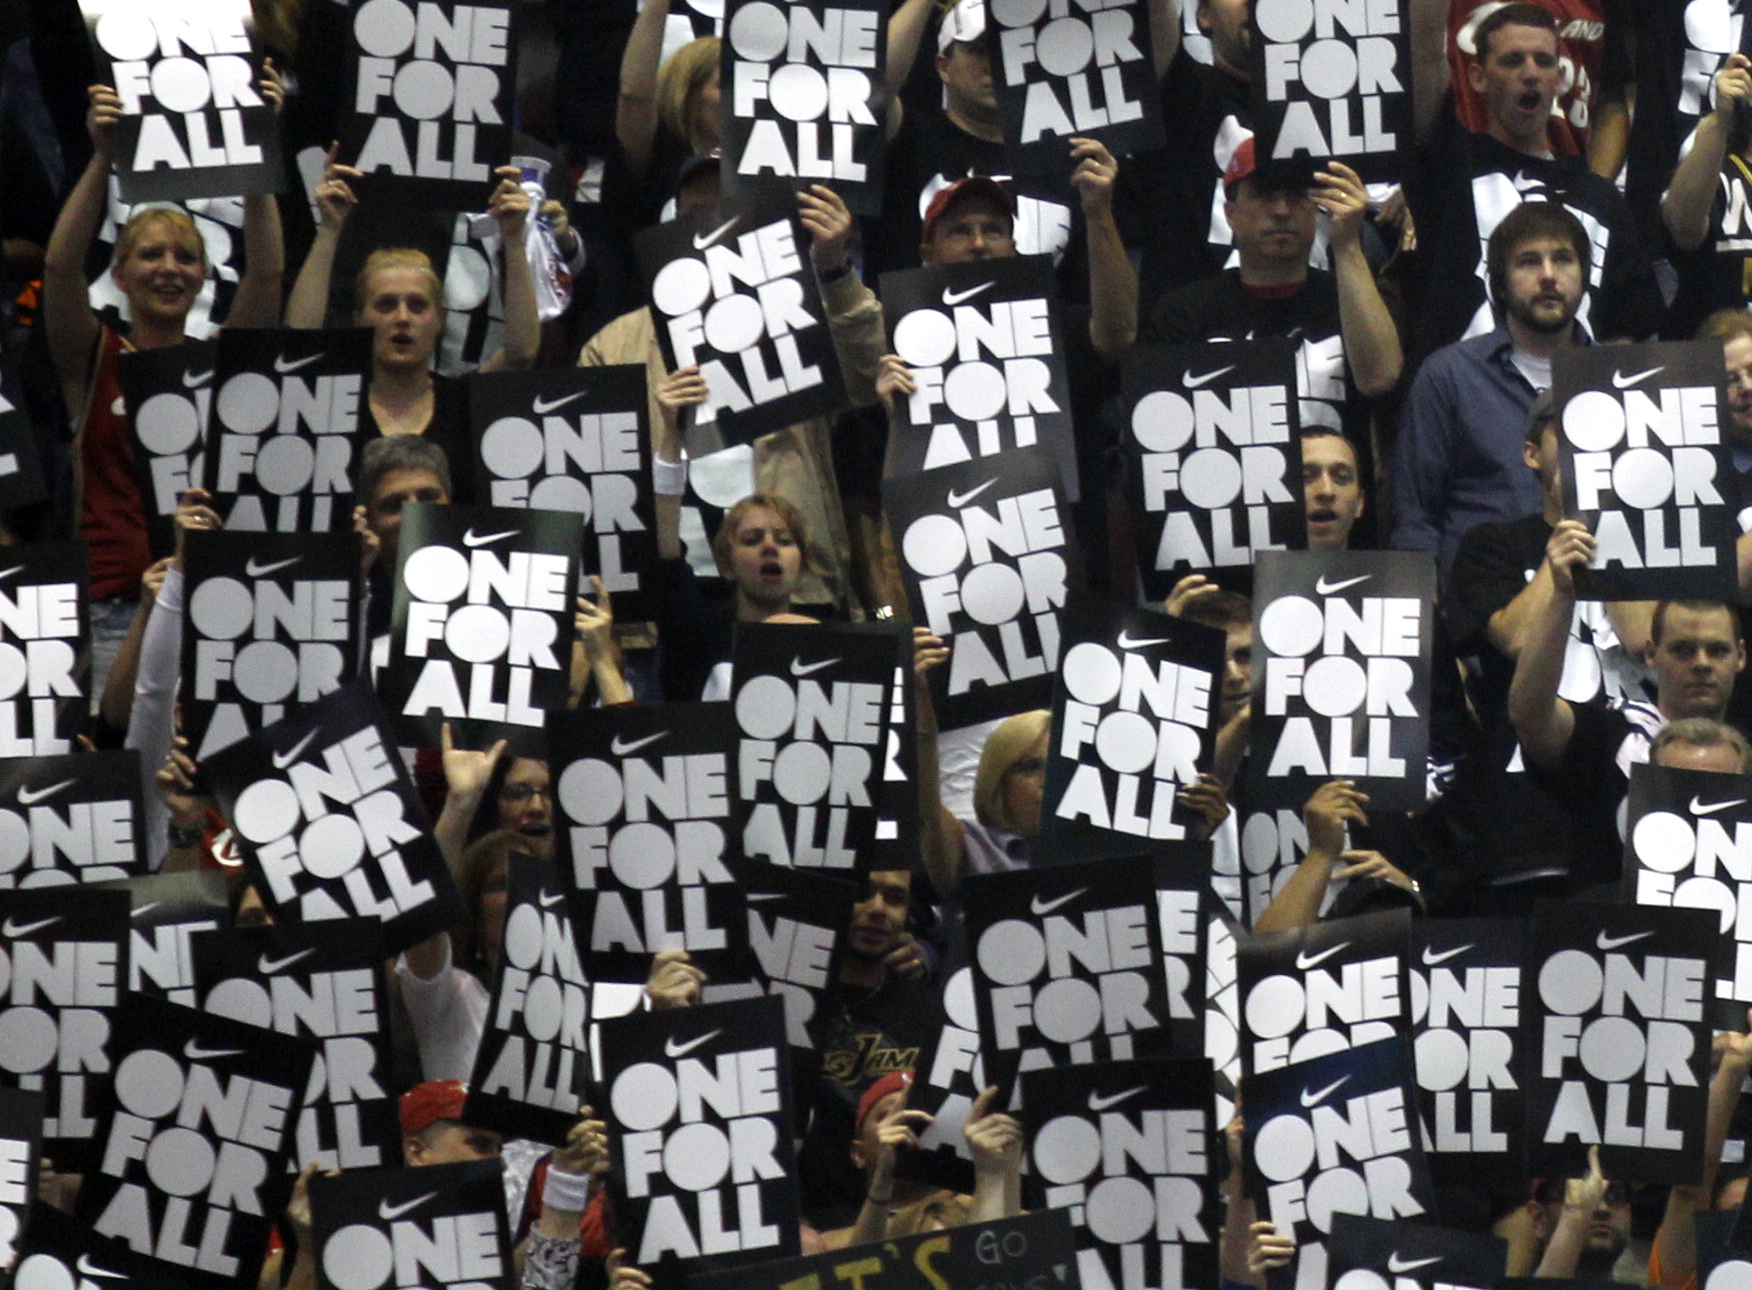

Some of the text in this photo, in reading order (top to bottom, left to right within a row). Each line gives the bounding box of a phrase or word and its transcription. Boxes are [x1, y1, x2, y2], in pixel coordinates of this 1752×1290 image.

[730, 3, 878, 68] ONE
[1264, 33, 1405, 101] FOR
[111, 50, 265, 116] FOR
[734, 59, 877, 126] FOR
[135, 110, 267, 171] ALL
[738, 118, 870, 183] ALL
[1275, 95, 1401, 160] ALL
[1564, 385, 1720, 453] ONE
[1573, 444, 1725, 511] FOR
[1587, 507, 1722, 571] ALL
[404, 544, 569, 612] ONE
[404, 599, 561, 669] FOR
[1260, 595, 1422, 658] ONE
[404, 659, 550, 726] ALL
[739, 674, 883, 746] ONE
[1264, 655, 1418, 719] FOR
[739, 737, 874, 809] FOR
[1268, 716, 1409, 777] ALL
[738, 802, 861, 868] ALL
[1538, 950, 1706, 1022] ONE
[1540, 1013, 1698, 1088] FOR
[115, 1049, 293, 1153] ONE
[612, 1046, 781, 1132] ONE
[1541, 1080, 1687, 1151] ALL
[102, 1108, 274, 1219] FOR
[623, 1111, 787, 1198] FOR
[90, 1180, 243, 1280] ALL
[638, 1184, 784, 1264] ALL
[975, 1230, 1027, 1264] GO
